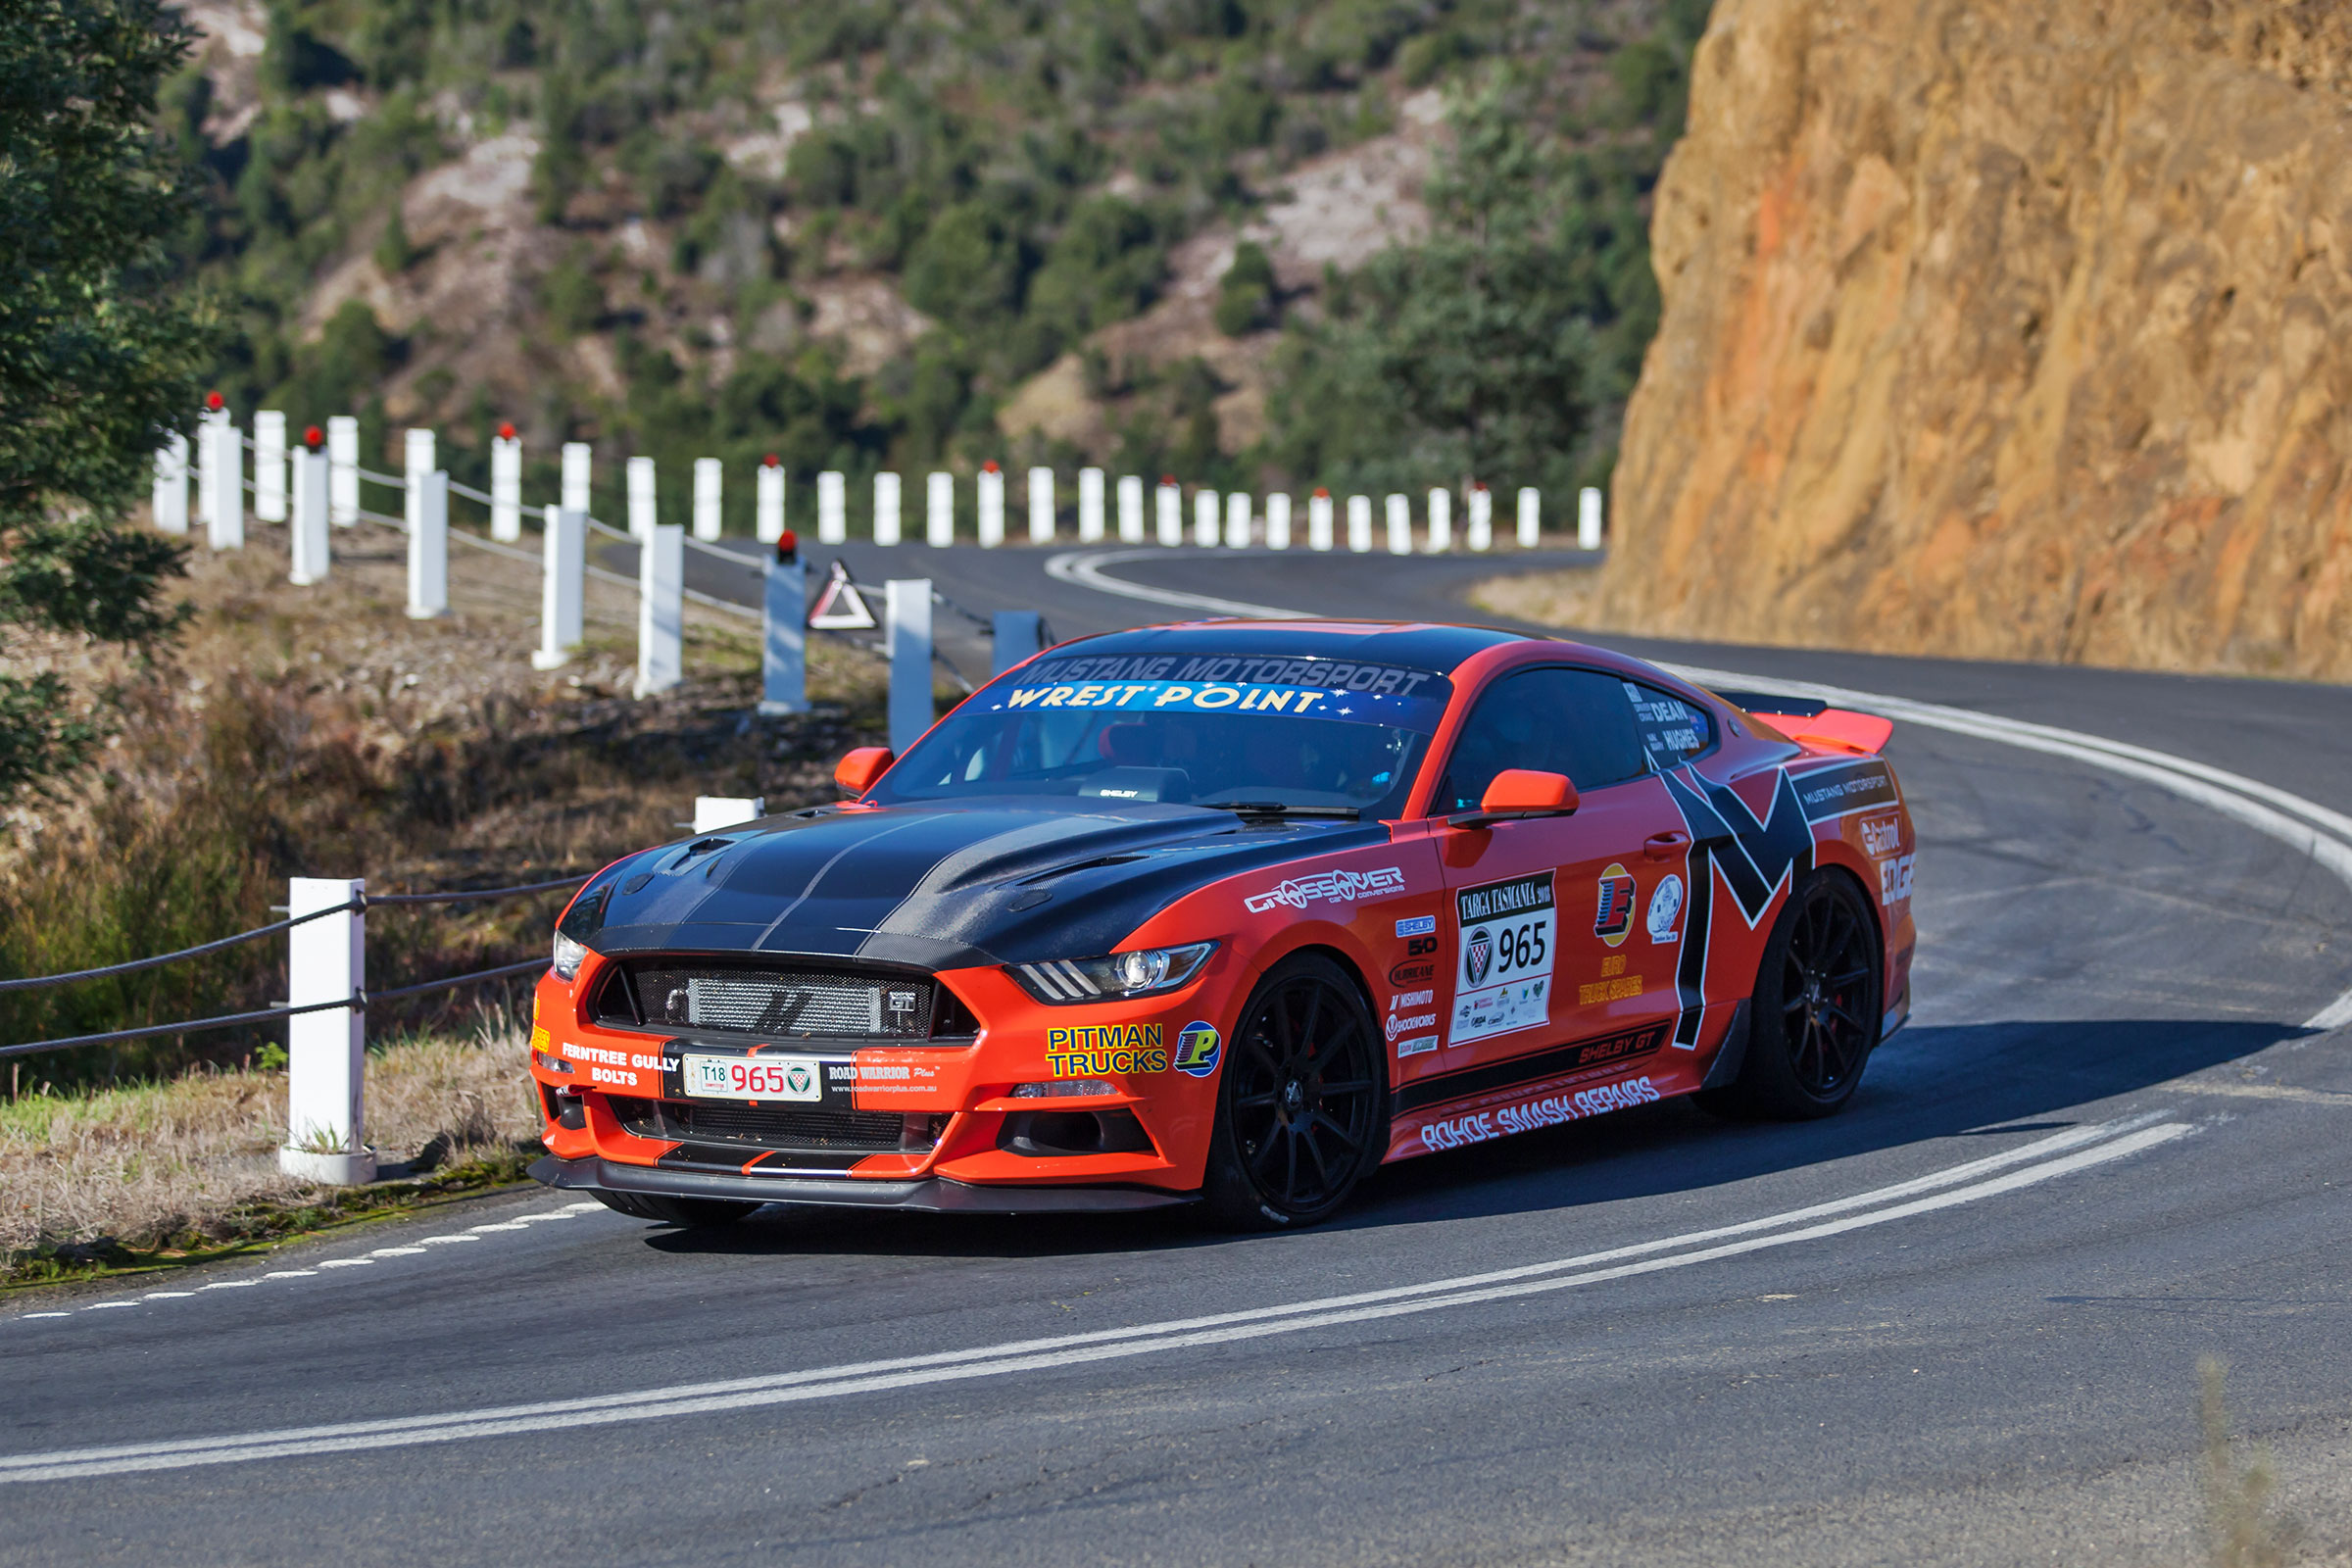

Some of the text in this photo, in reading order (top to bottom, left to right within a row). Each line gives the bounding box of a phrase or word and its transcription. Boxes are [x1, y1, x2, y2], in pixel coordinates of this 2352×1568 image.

[1013, 656, 1431, 697] MUSTANG MOTORSPORT
[1006, 683, 1325, 714] WREST POINT
[1650, 701, 1689, 722] DEAN
[1662, 728, 1700, 752] HUGHES
[1100, 789, 1138, 799] SHELBY
[1803, 774, 1886, 805] MUSTANG MOTORSPORT
[1244, 866, 1405, 913] CROSSOVER
[1357, 884, 1405, 900] conversions
[1460, 891, 1492, 921] TARGA
[1491, 881, 1537, 914] TASMANIA
[1404, 919, 1434, 932] SHELBY
[1497, 919, 1547, 974] 965
[1399, 989, 1434, 1008] MISHIMOTO
[1579, 974, 1643, 1005] TRUCK SPARES
[1046, 1022, 1164, 1053] PITMAN
[1578, 1032, 1656, 1064] SHELBY GT
[562, 1042, 681, 1072] FERNTREE GULLY
[1045, 1049, 1168, 1078] TRUCKS
[591, 1067, 638, 1087] BOLTS
[702, 1066, 726, 1082] T18
[731, 1064, 784, 1093] 965
[828, 1065, 936, 1080] ROAD WARRIOR Plus
[831, 1084, 938, 1094] www.roadwarriorplus.com.au
[1421, 1075, 1661, 1152] ROHDE SMASH REPAIRS
